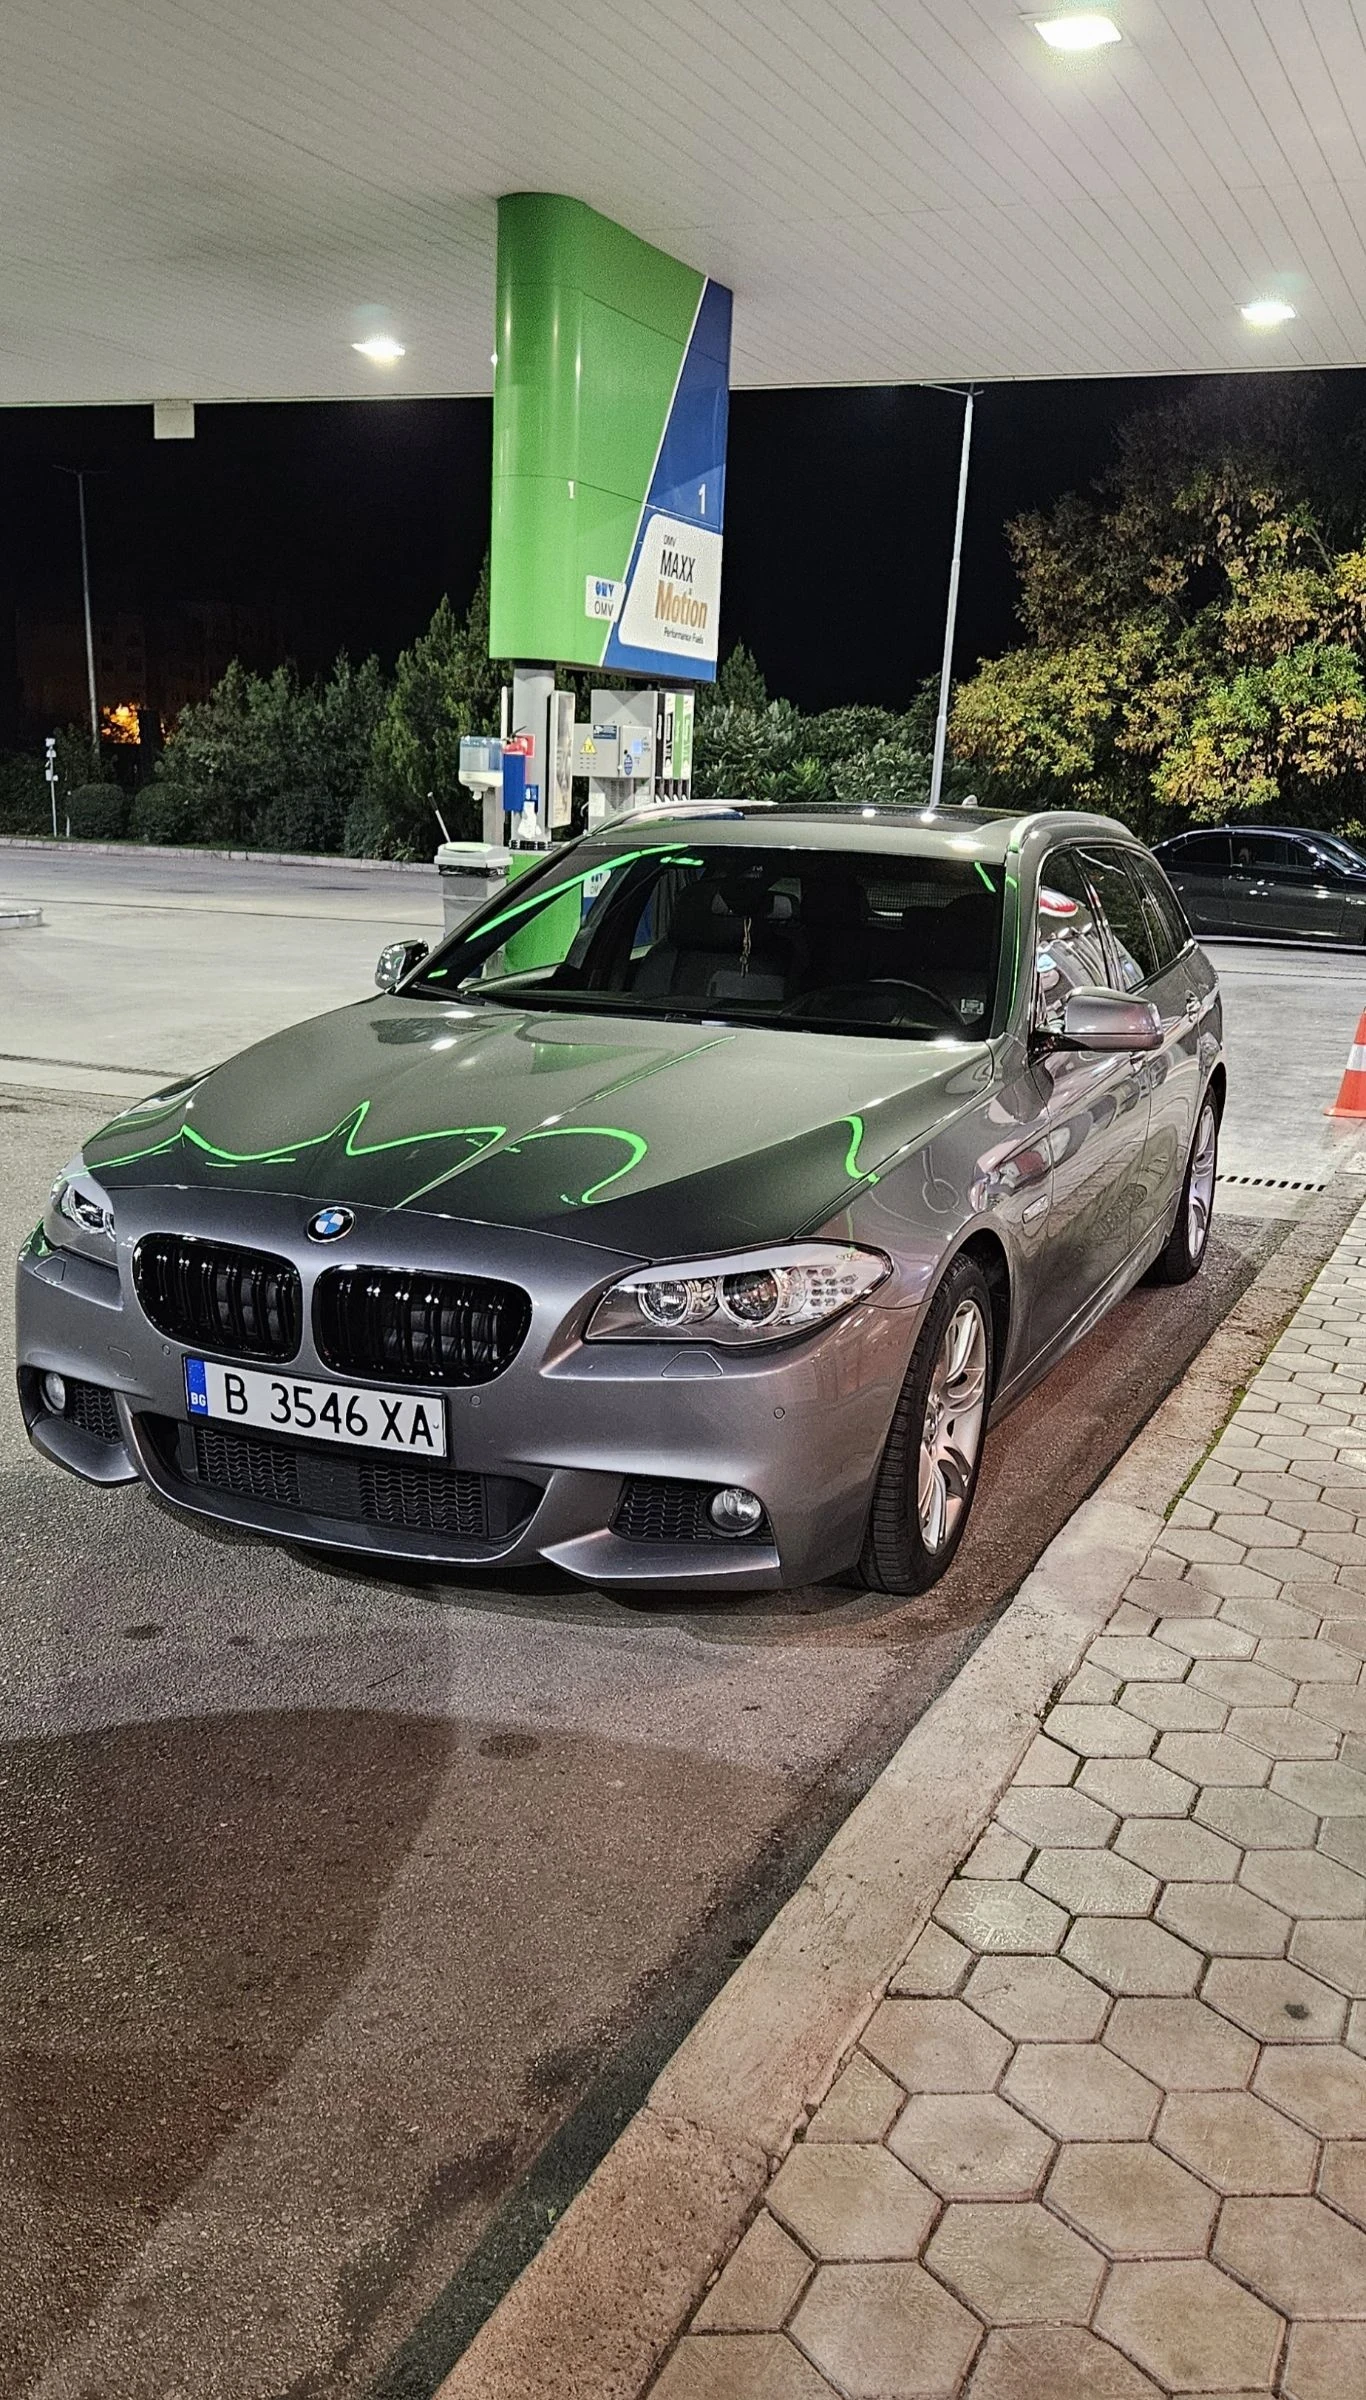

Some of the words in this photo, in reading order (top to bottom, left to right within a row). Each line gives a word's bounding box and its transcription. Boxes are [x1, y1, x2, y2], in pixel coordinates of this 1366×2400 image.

[568, 481, 574, 499] 1
[699, 483, 706, 514] 1
[663, 534, 677, 547] OMV
[660, 549, 696, 583] MAXX
[594, 600, 614, 617] OMV
[655, 580, 708, 629] Motion
[190, 1392, 207, 1407] BG
[224, 1372, 248, 1415] B
[270, 1382, 368, 1437] 3546
[379, 1399, 434, 1447] XA
